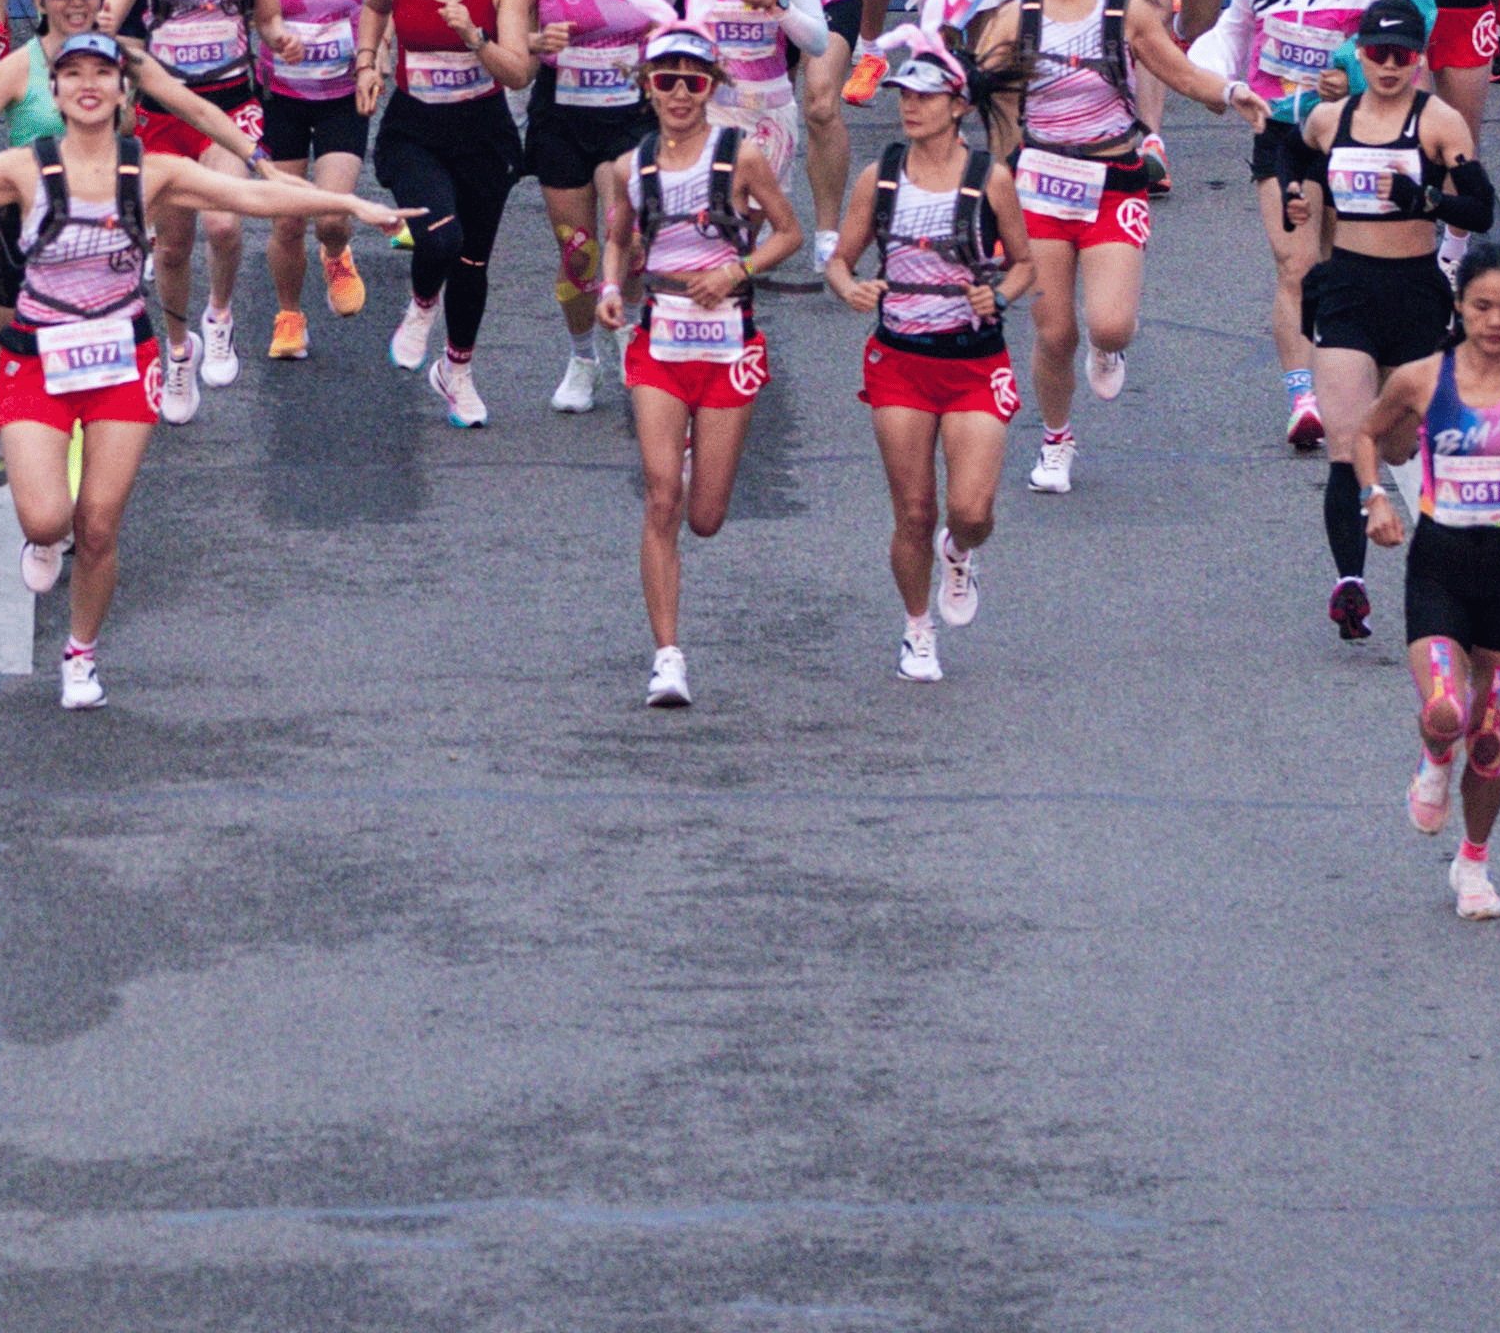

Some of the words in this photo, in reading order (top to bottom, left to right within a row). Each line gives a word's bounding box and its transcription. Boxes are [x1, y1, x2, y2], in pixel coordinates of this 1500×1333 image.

[717, 23, 762, 41] 1556
[176, 43, 223, 62] 0863
[303, 42, 340, 60] 776
[1281, 45, 1326, 67] 0309
[433, 68, 480, 86] 0481
[580, 68, 626, 86] 1224
[1039, 177, 1085, 200] 1672
[675, 321, 723, 342] 0300
[69, 343, 117, 365] 1677
